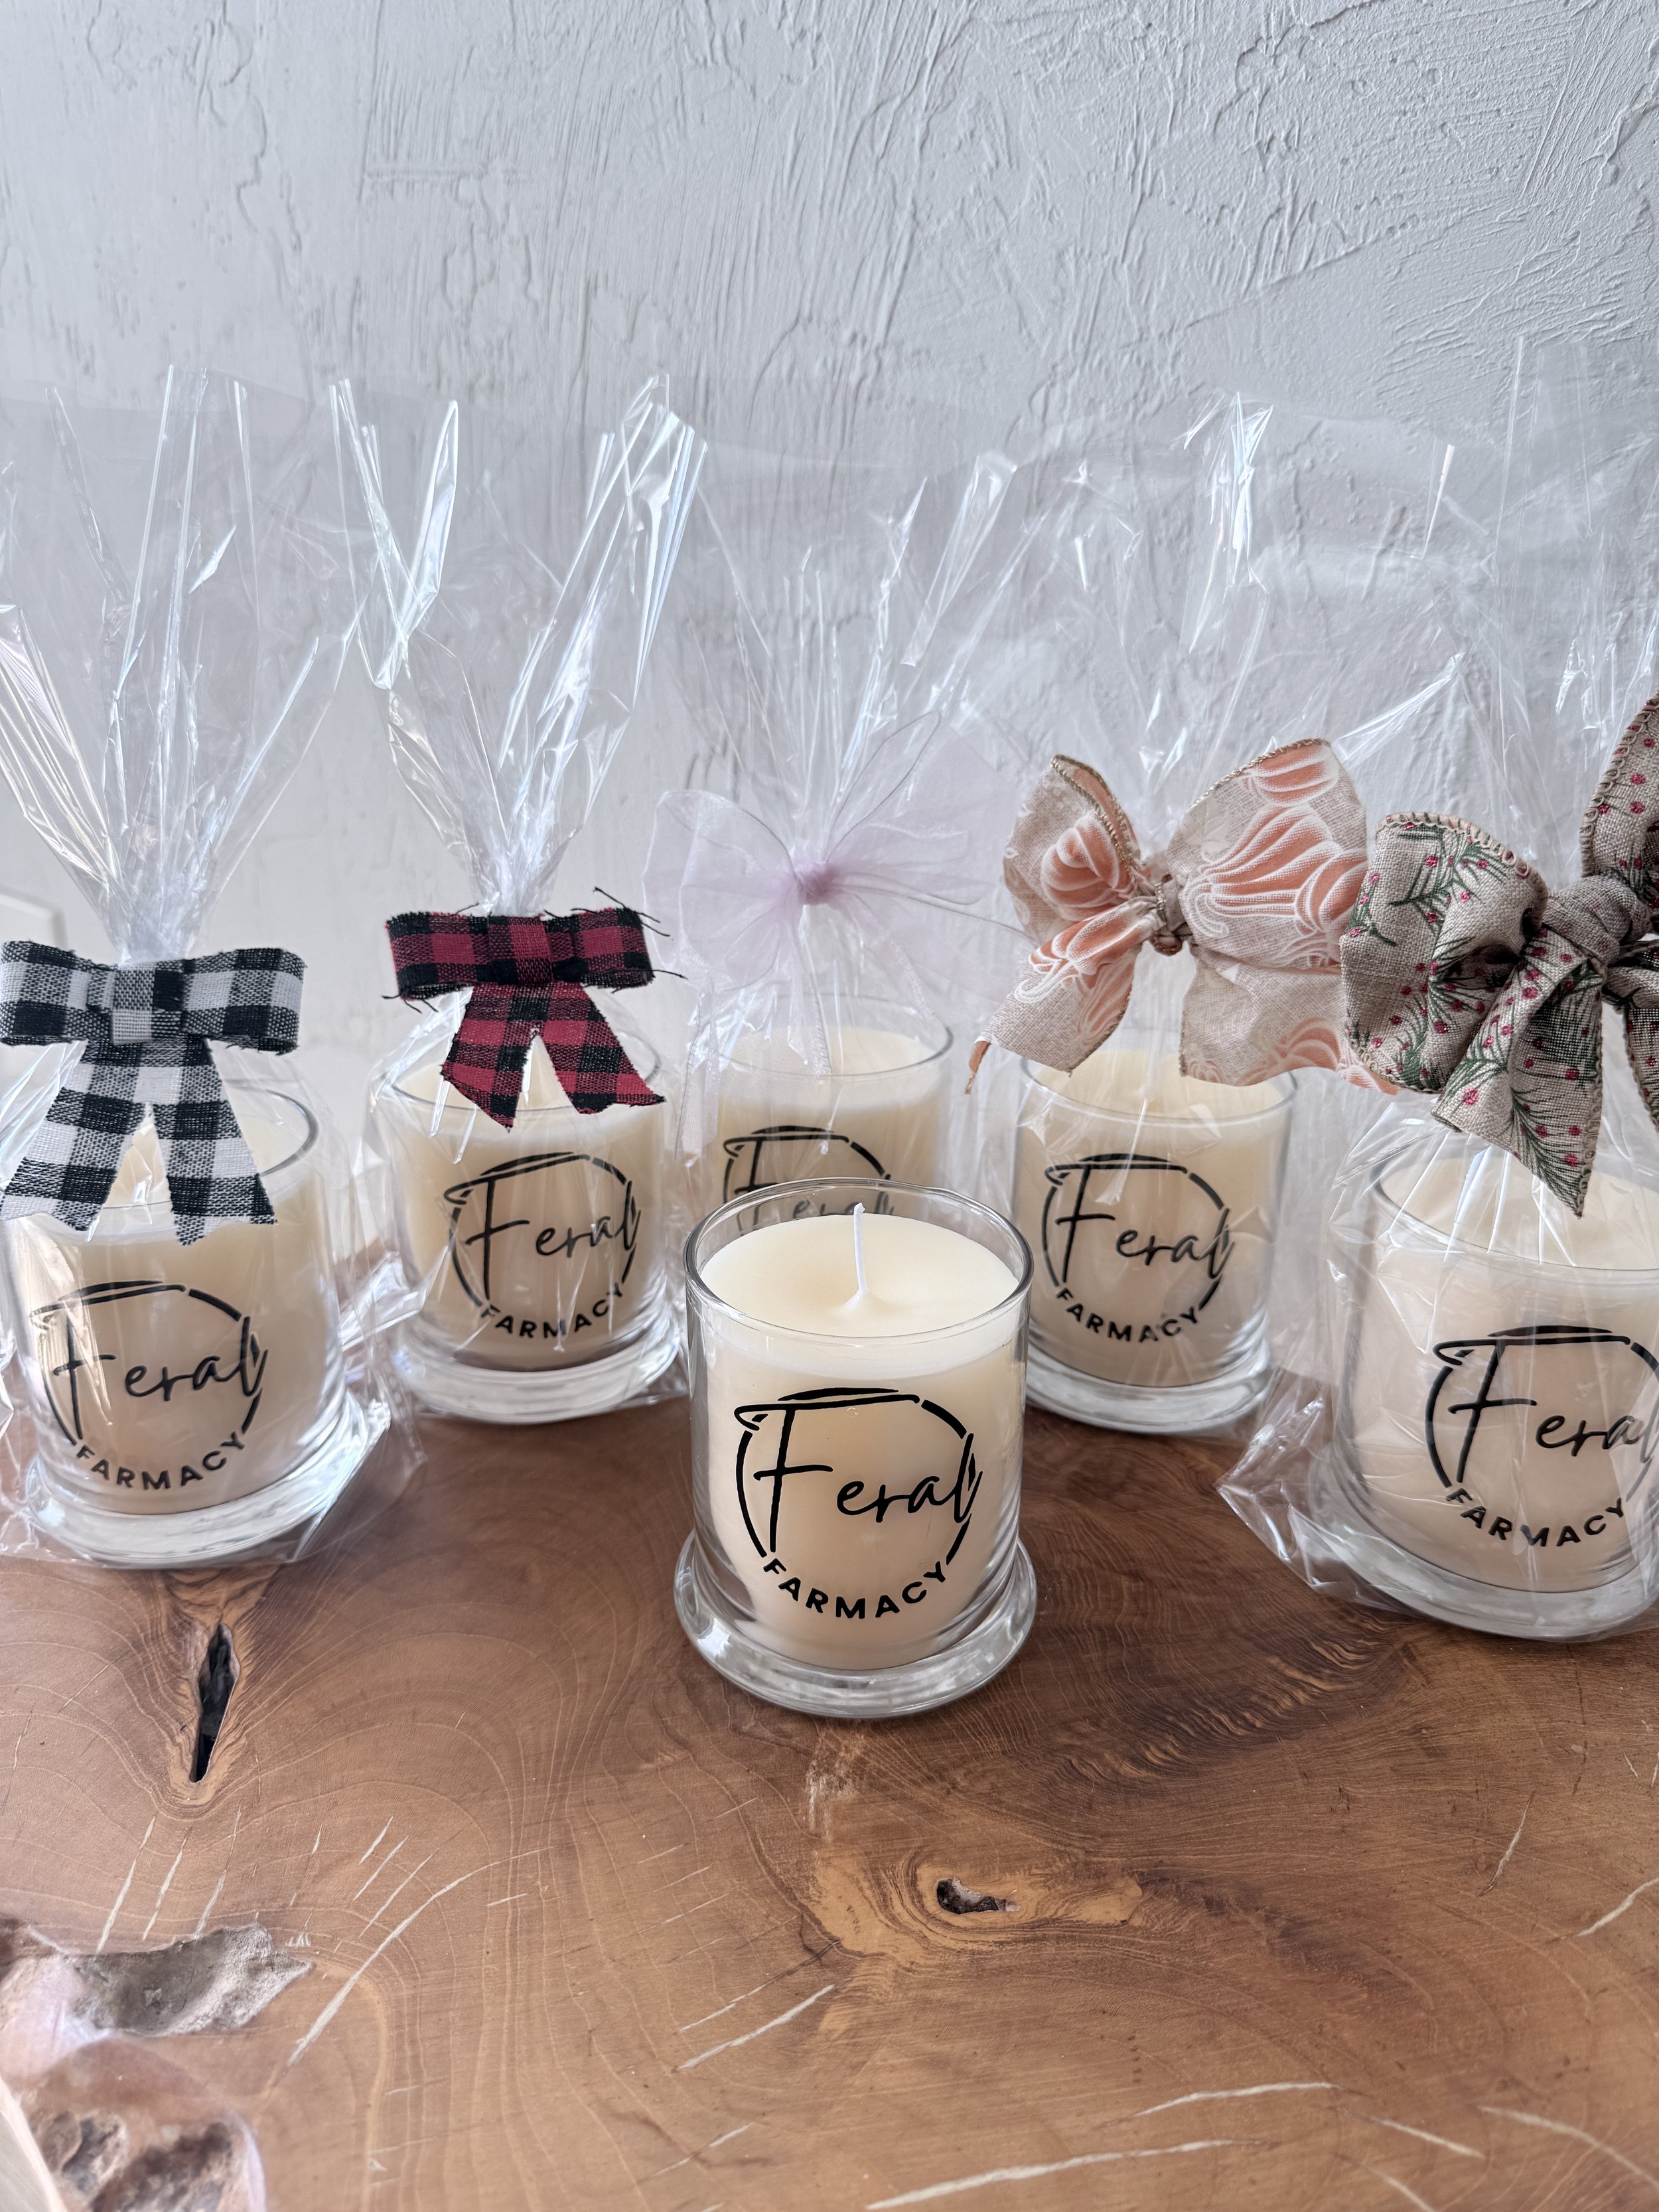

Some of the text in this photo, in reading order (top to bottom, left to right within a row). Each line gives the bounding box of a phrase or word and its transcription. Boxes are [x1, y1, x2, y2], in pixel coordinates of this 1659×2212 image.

[444, 1154, 642, 1301] Feral
[1044, 1163, 1235, 1284] Feral
[480, 1282, 624, 1339] FARMACY
[1056, 1288, 1198, 1343] FARMACY
[30, 1284, 269, 1439] Feral
[1432, 1335, 1659, 1483] Feral
[76, 1431, 246, 1491] FARMACY
[733, 1394, 983, 1553] Feral
[1445, 1497, 1624, 1548] FARMACY
[762, 1558, 947, 1619] FARMACY
